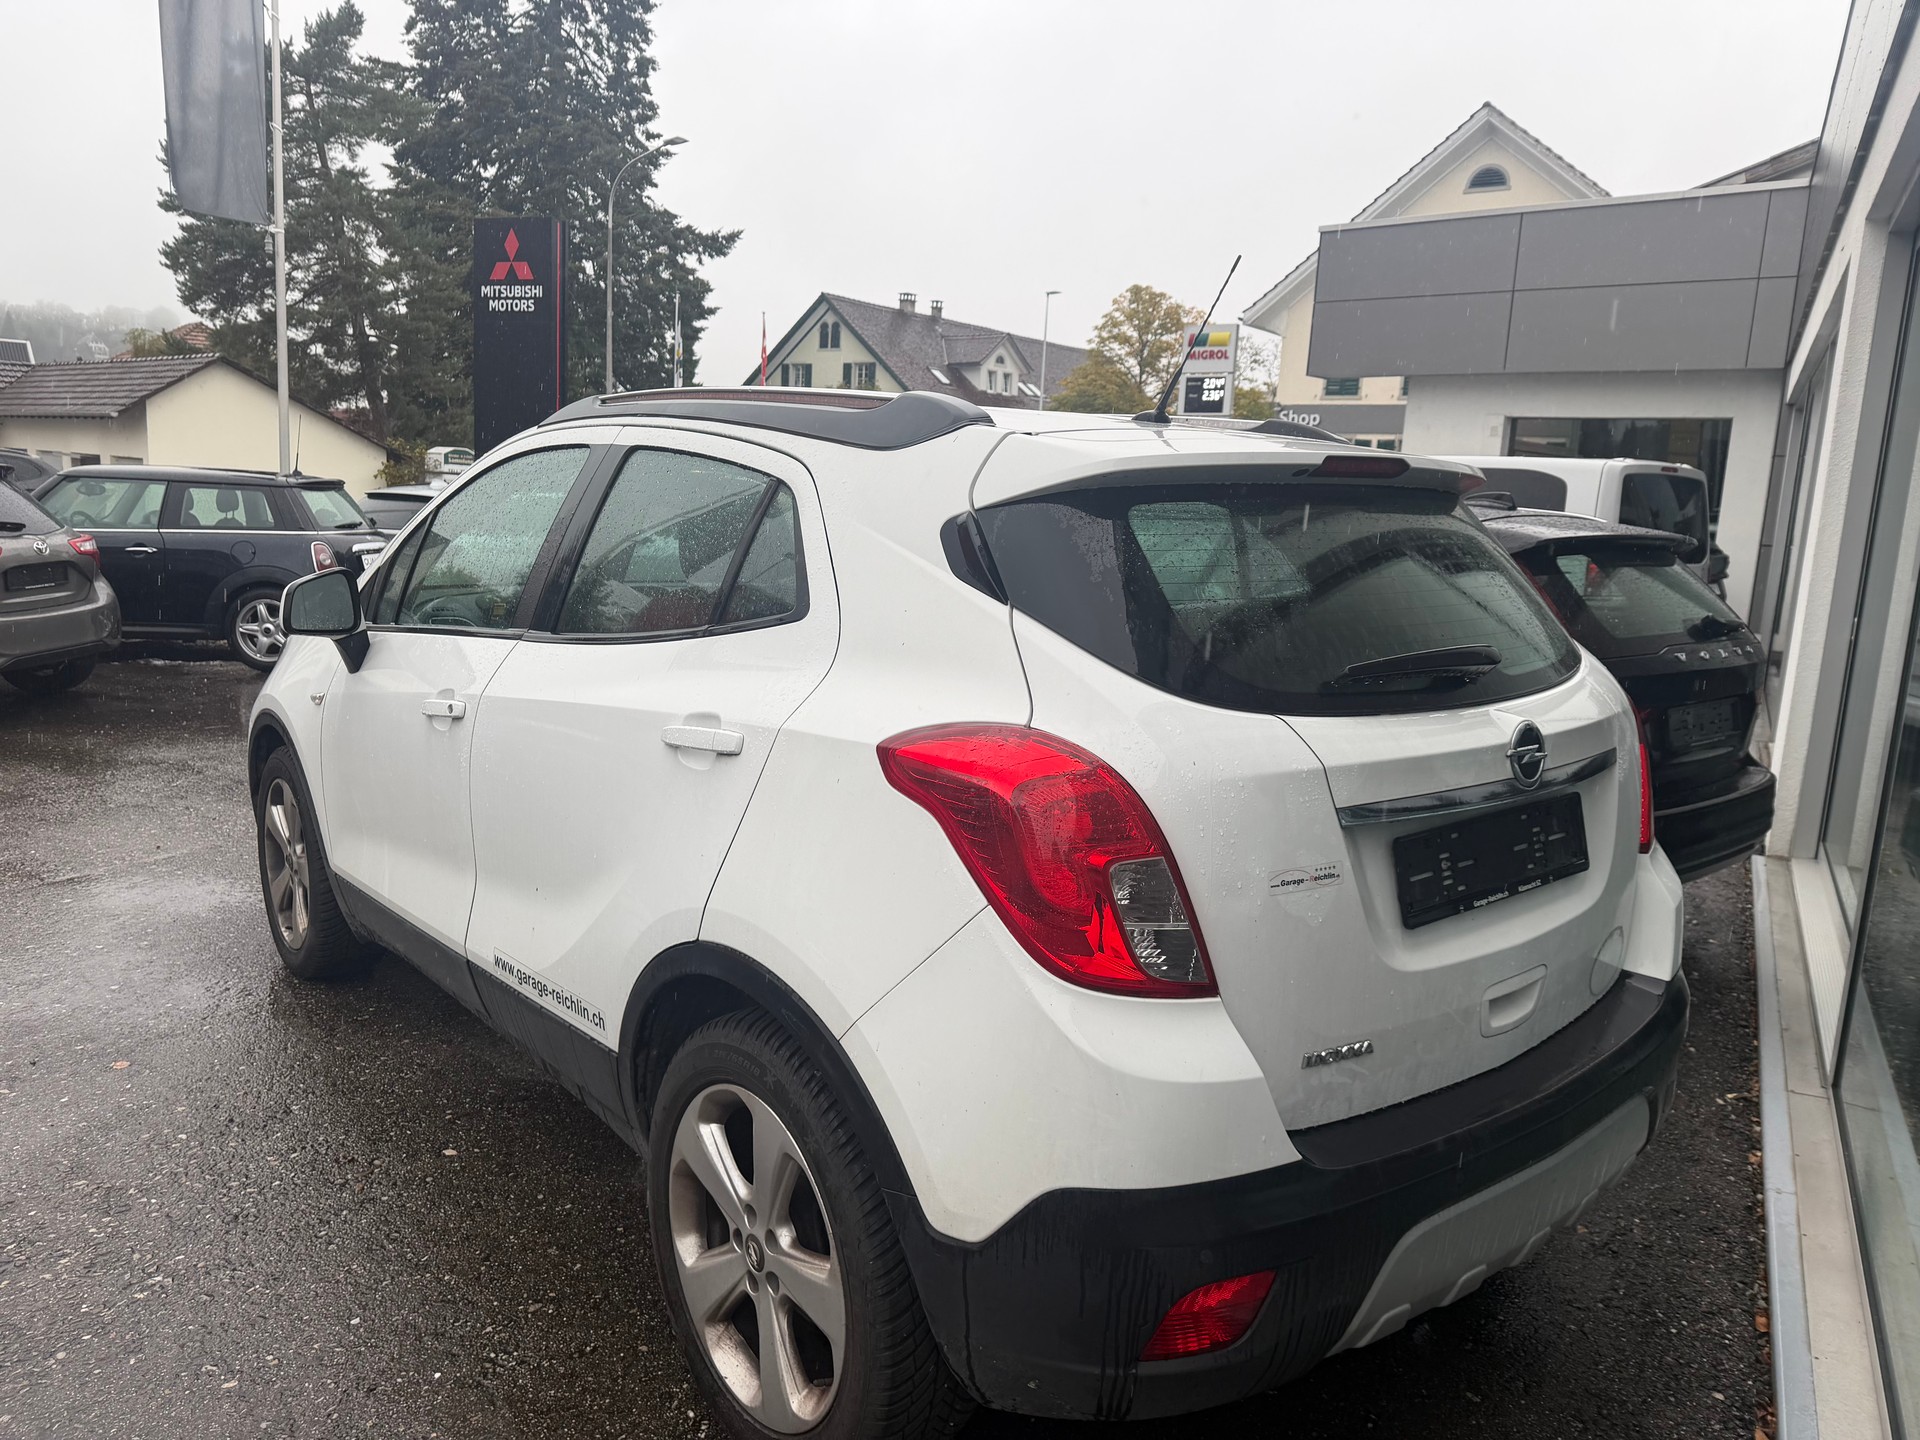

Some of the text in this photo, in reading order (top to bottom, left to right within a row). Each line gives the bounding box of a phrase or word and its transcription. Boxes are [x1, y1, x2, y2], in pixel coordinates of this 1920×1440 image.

[481, 285, 543, 298] MITSUBISHI
[489, 299, 535, 312] MOTORS
[1188, 349, 1229, 360] MIGROL
[1279, 409, 1321, 426] Shop
[493, 954, 606, 1032] www.garage-reichlin.ch
